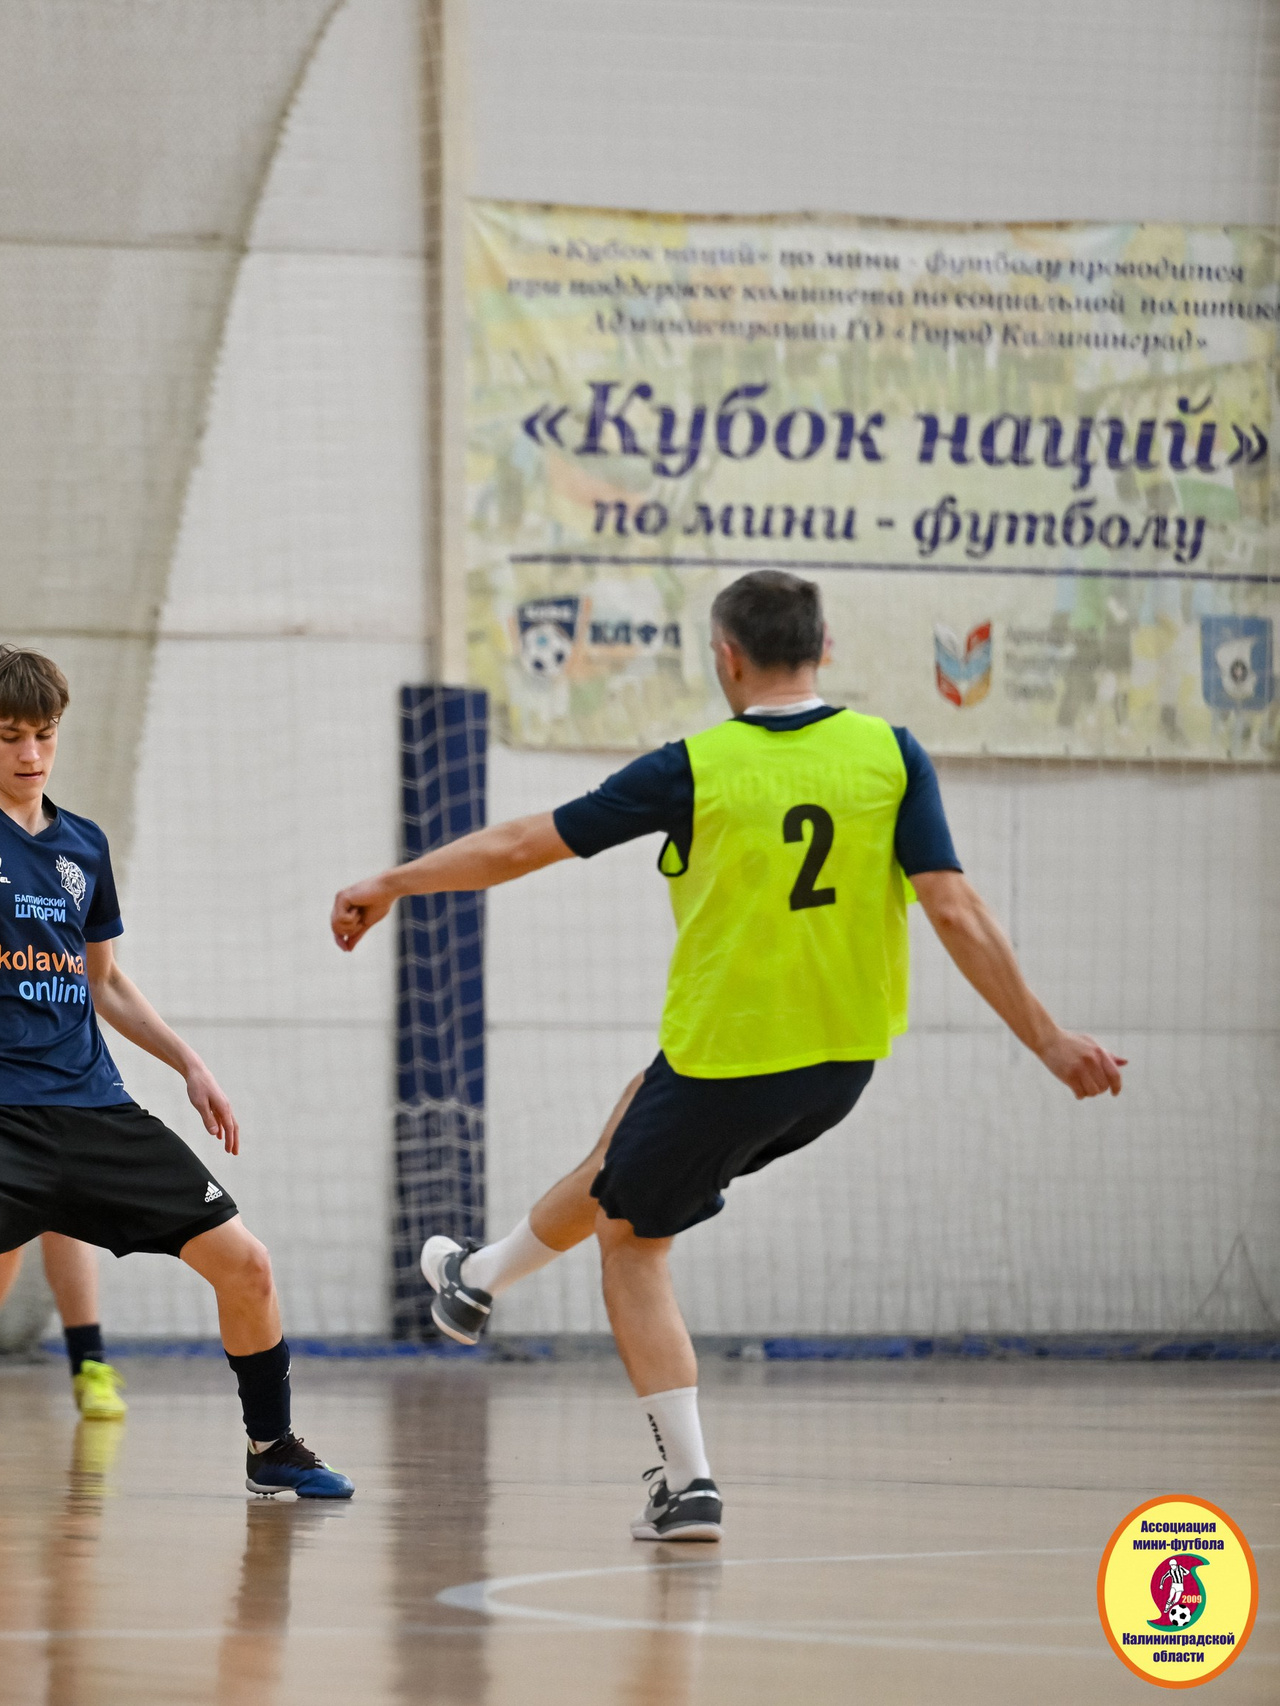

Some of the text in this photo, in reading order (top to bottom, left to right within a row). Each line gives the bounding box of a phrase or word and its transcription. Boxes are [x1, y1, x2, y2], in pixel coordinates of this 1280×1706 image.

[779, 250, 814, 268] по
[823, 251, 900, 271] мини
[925, 247, 1063, 284] футболу
[1069, 256, 1246, 286] проводится
[568, 274, 734, 304] поддержке
[741, 283, 904, 305] комитета
[913, 290, 948, 307] по
[954, 289, 1125, 316] социальной
[522, 380, 1269, 490] «Кубок наций»
[592, 499, 669, 537] по
[681, 501, 857, 541] мини
[912, 494, 1207, 565] футболу
[782, 803, 837, 912] 2
[14, 893, 67, 908] БАЛТИЙСКИЙ
[15, 903, 67, 924] ШТОРМ
[18, 975, 87, 1005] online
